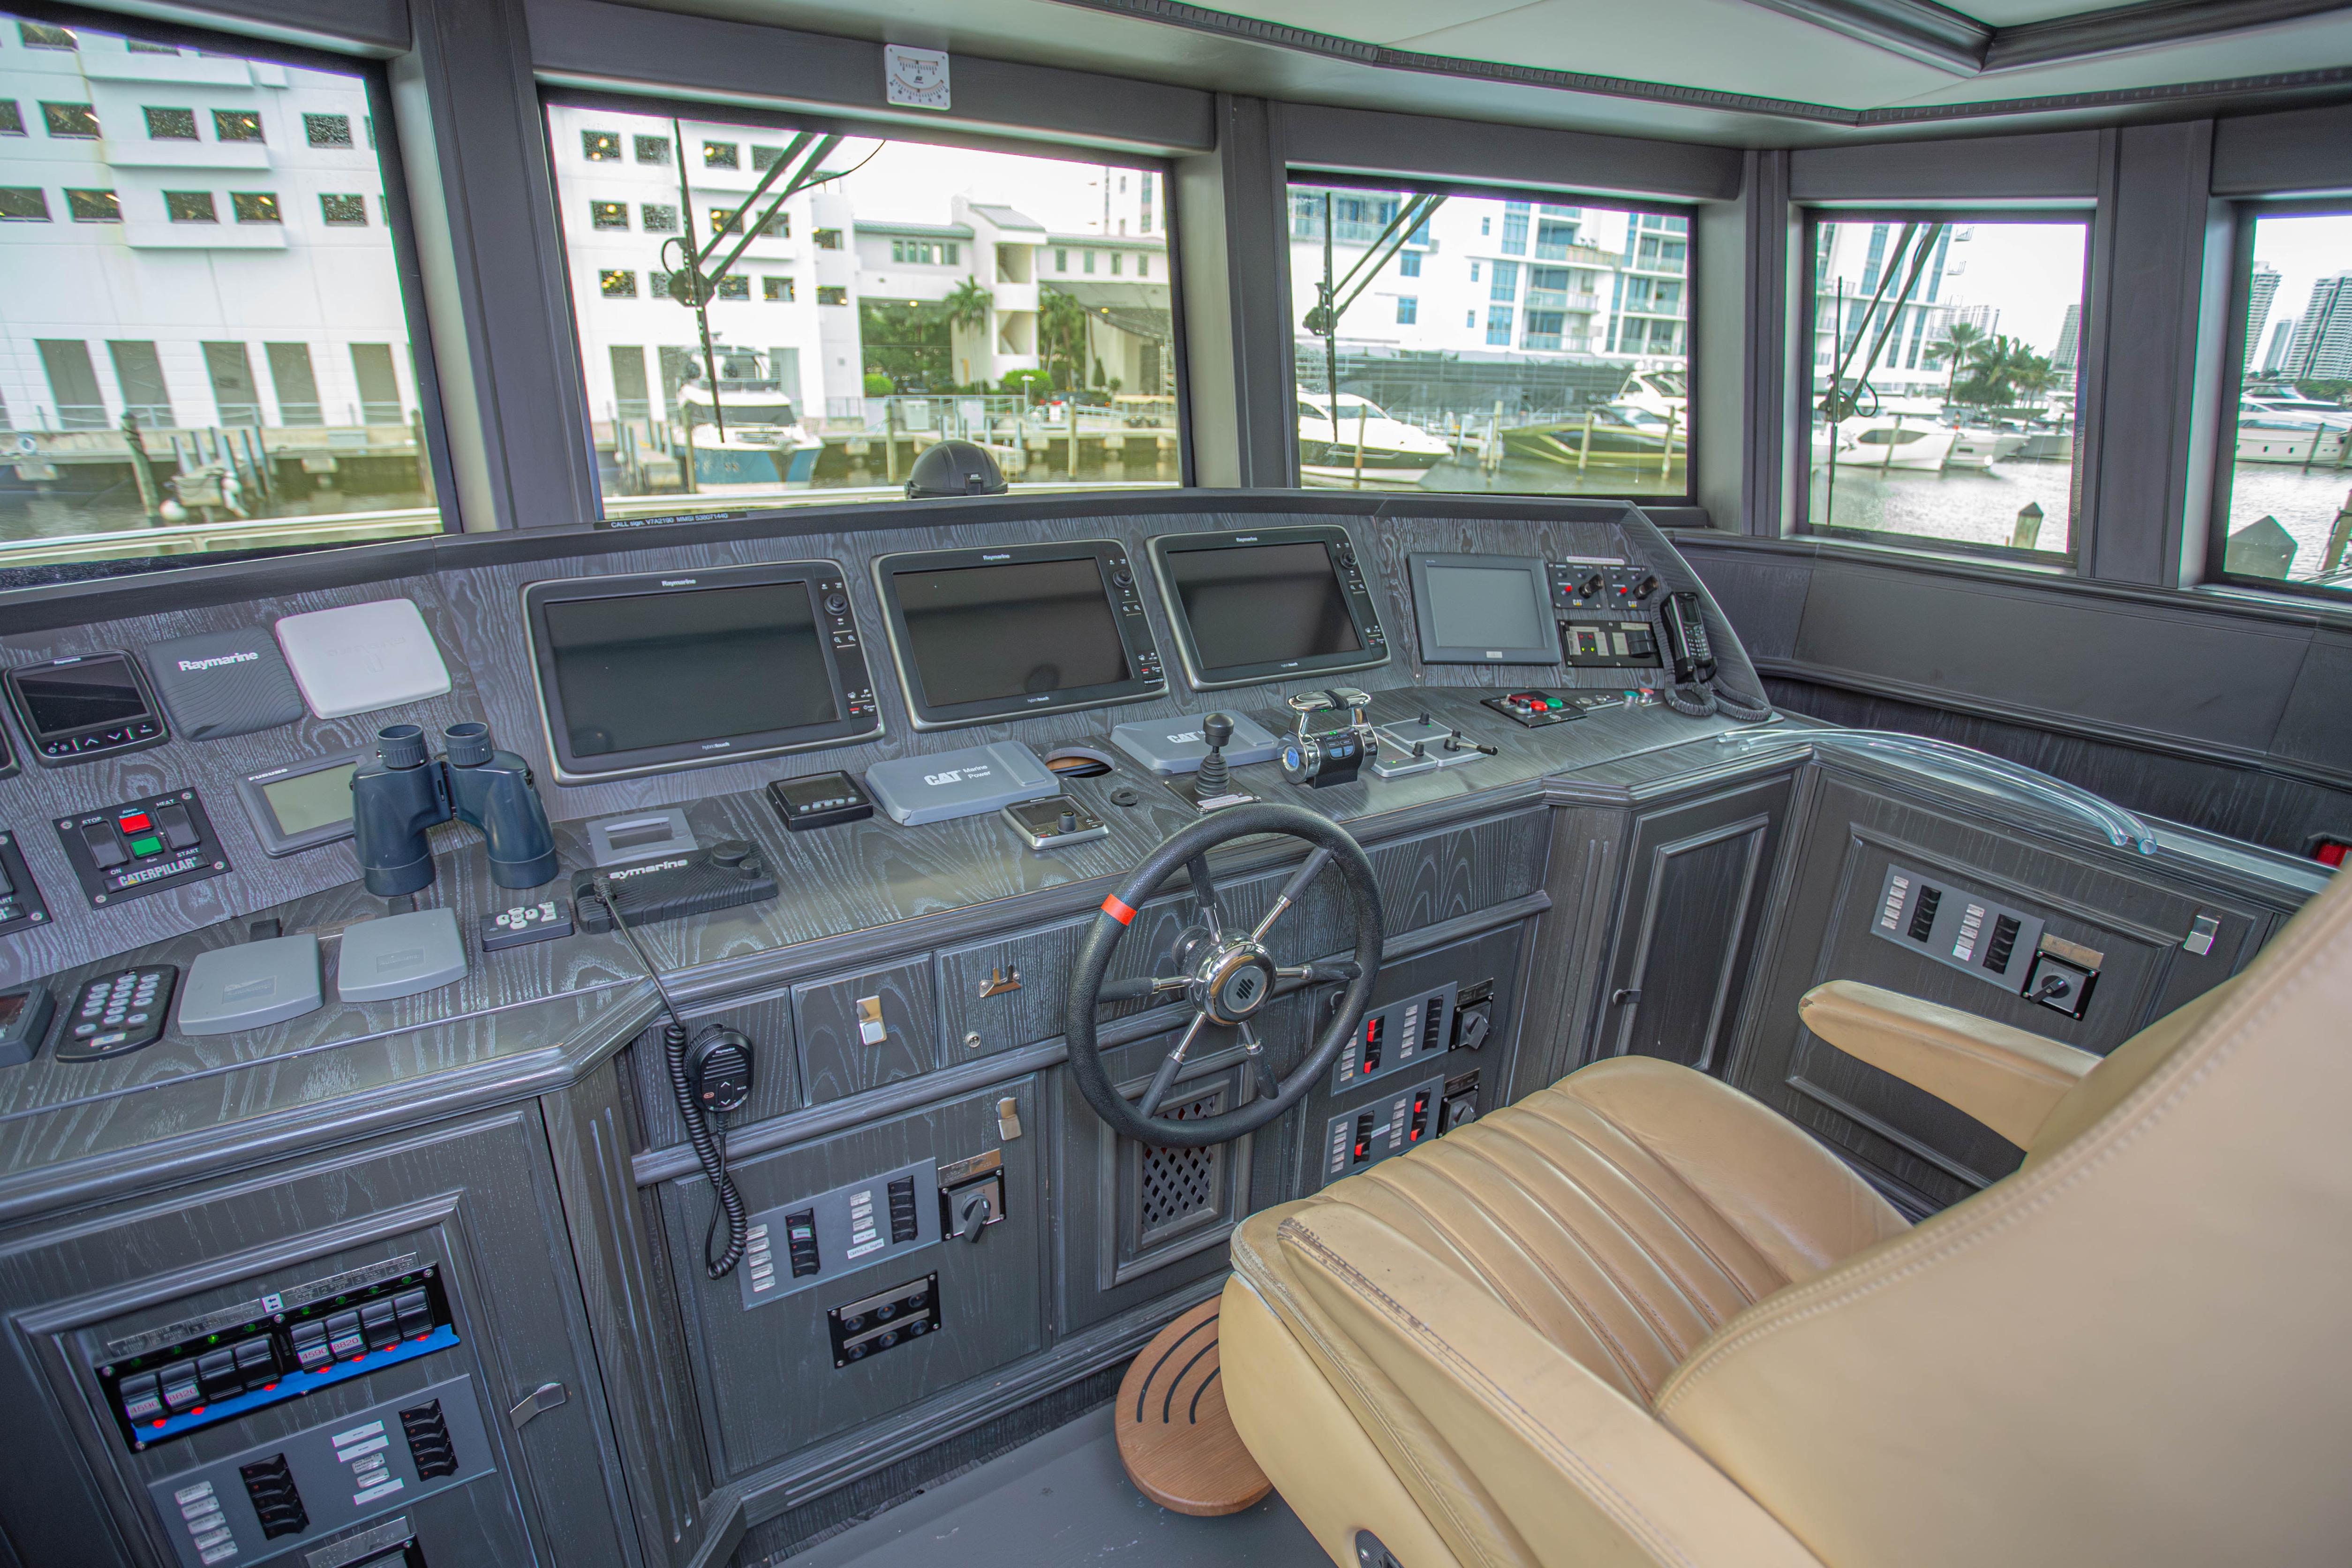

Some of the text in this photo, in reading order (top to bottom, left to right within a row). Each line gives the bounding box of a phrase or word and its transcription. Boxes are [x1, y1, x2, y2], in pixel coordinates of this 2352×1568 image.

[662, 578, 696, 587] Raymarine
[179, 651, 258, 671] Raymarine
[1167, 732, 1200, 743] CAT
[249, 769, 287, 781] FURUNO
[924, 770, 962, 785] CAT
[176, 848, 199, 857] START
[119, 857, 197, 886] CATERPILLAR
[610, 859, 688, 879] aymarine
[334, 1337, 359, 1350] 8820
[302, 1347, 328, 1360] 4590
[168, 1387, 198, 1402] 8820
[130, 1400, 159, 1414] 4590
